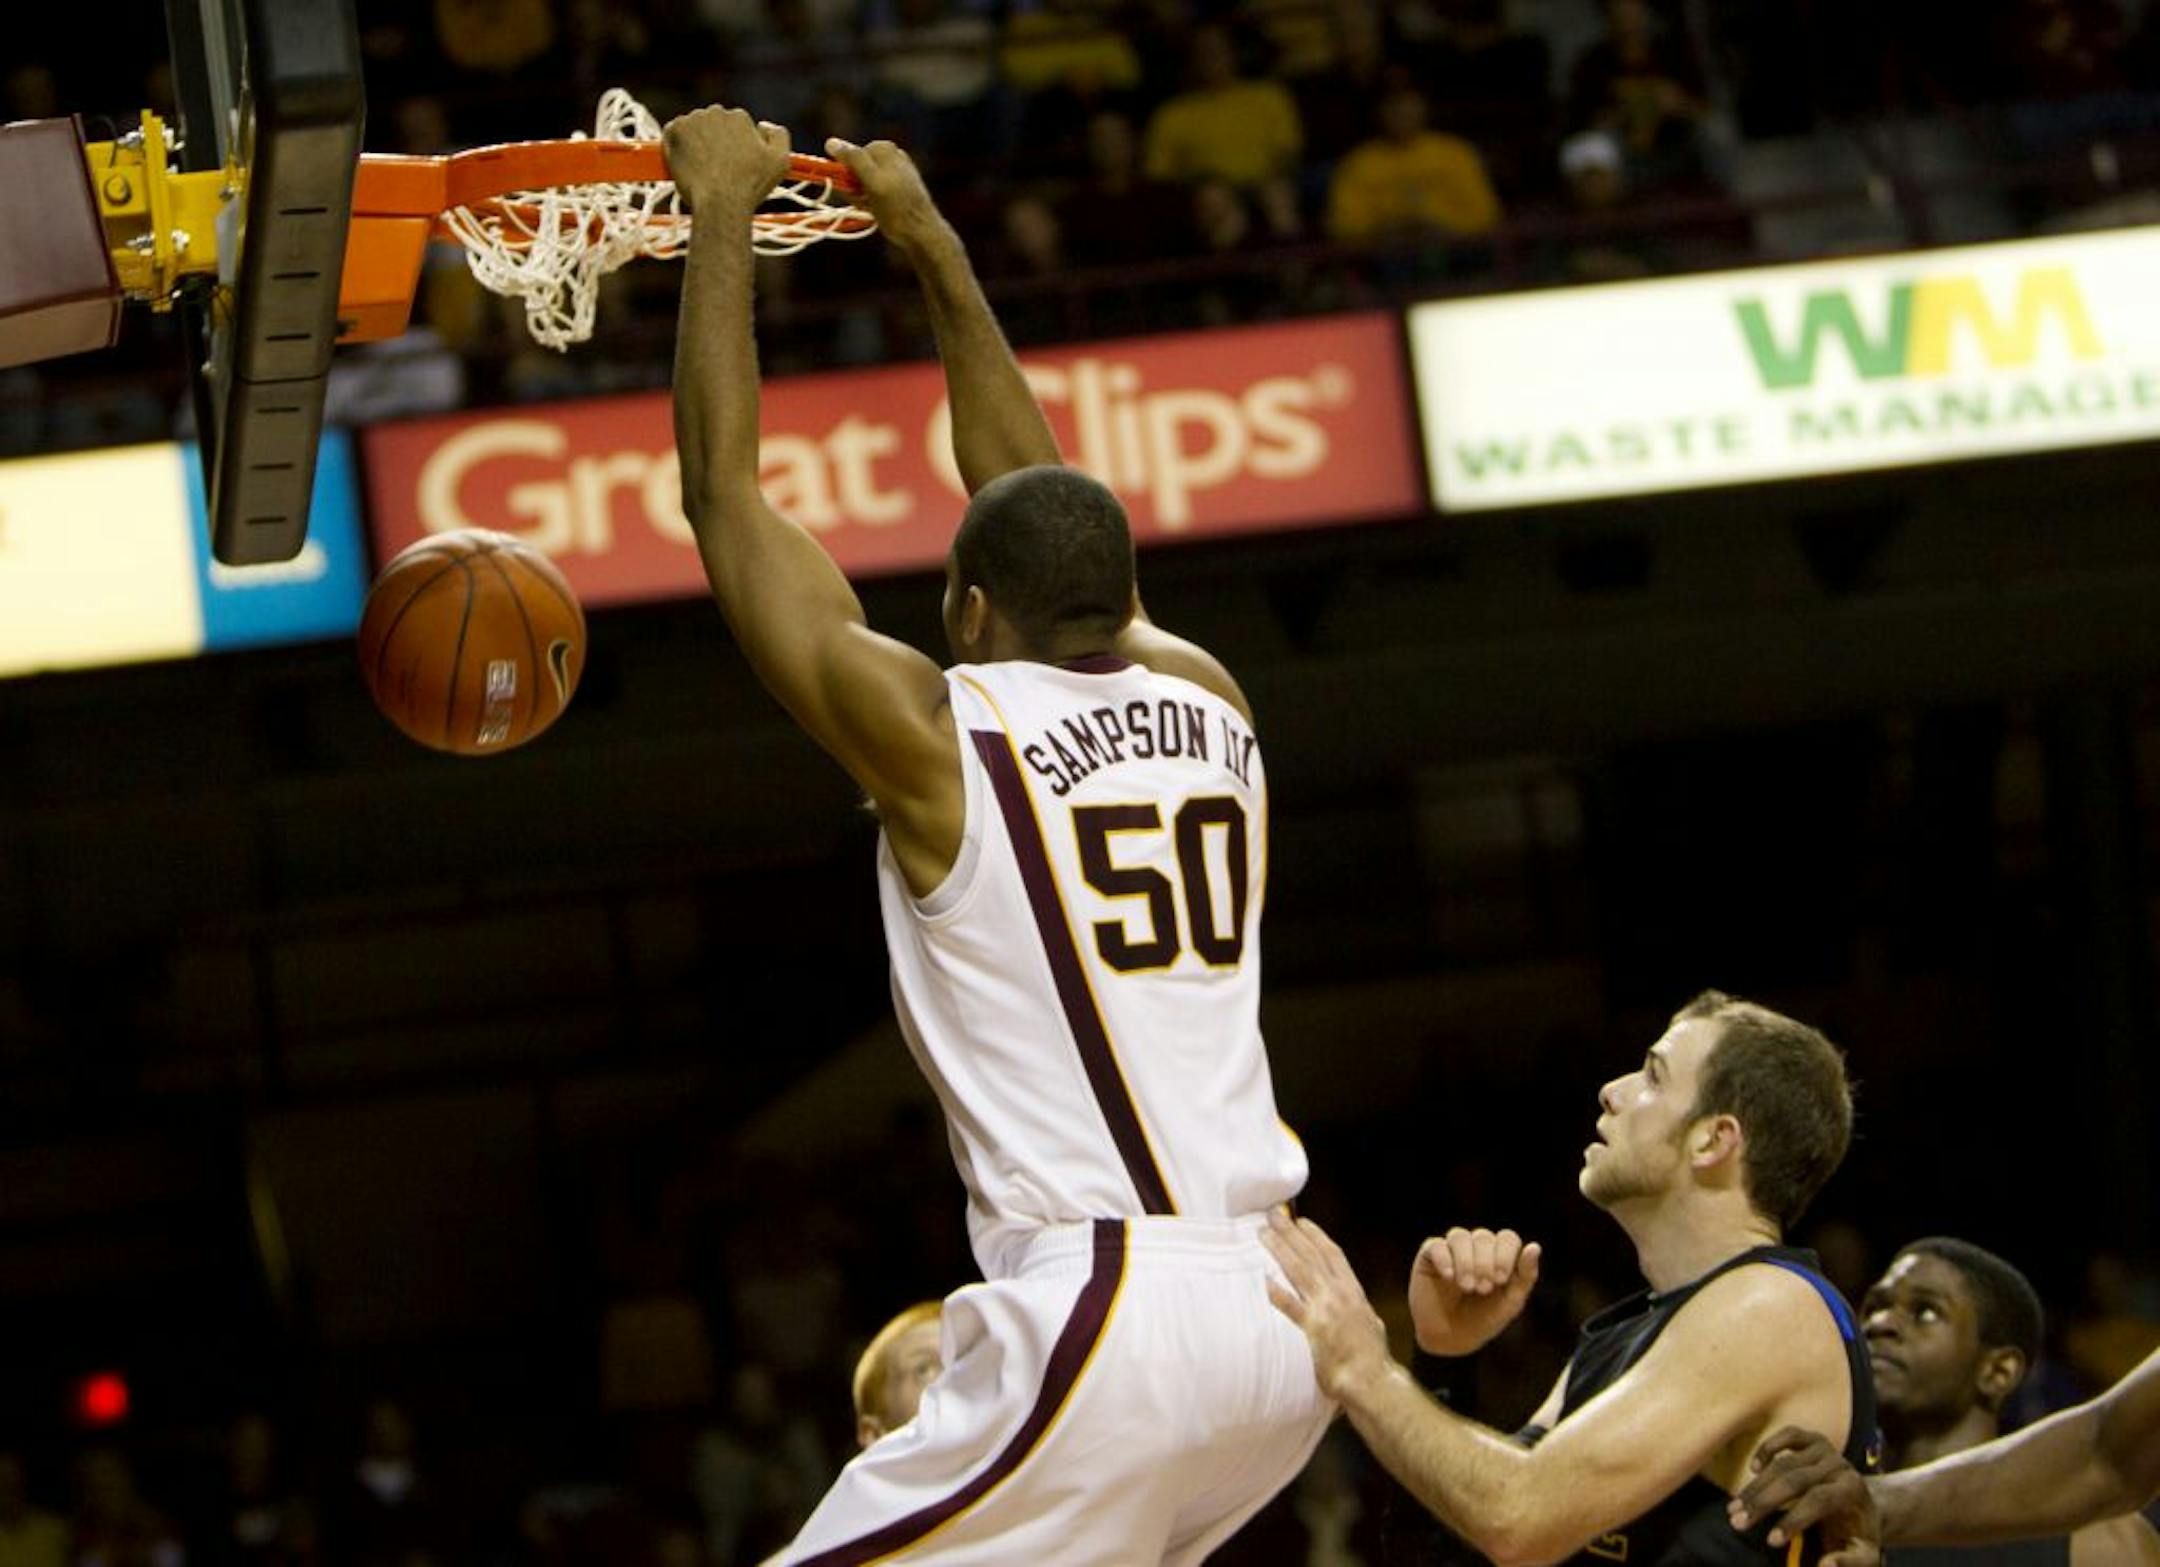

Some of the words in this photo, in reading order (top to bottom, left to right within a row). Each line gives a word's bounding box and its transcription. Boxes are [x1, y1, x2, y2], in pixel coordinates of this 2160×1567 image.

[1726, 262, 2108, 393] WM
[1453, 414, 1749, 482] WASTE
[1786, 368, 2160, 442] MANAGE
[1023, 699, 1209, 797] SAMPSON
[1222, 716, 1256, 787] III
[1069, 795, 1249, 977] 50
